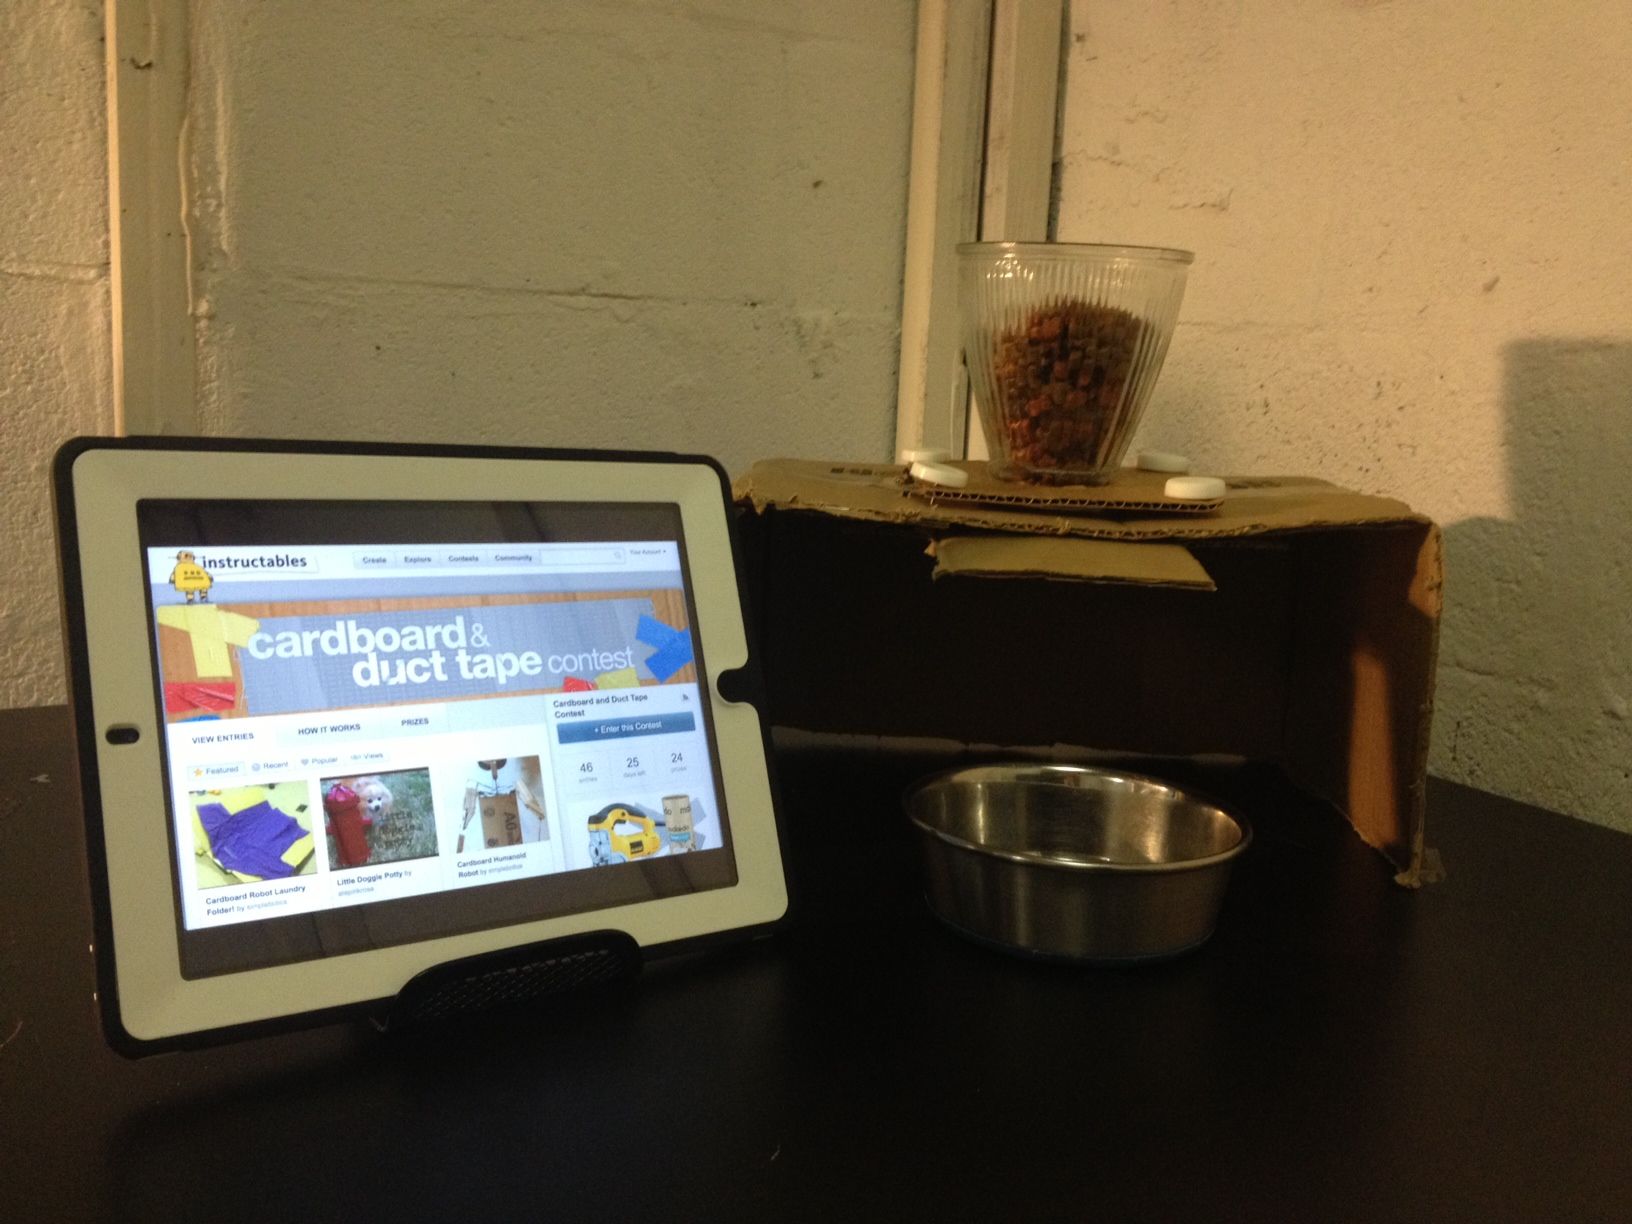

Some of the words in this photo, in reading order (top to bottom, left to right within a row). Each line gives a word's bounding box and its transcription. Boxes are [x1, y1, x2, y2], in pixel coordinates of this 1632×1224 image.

[202, 553, 307, 570] instructables
[362, 556, 387, 565] Create
[403, 555, 432, 565] Explore
[448, 554, 479, 563] Contests
[494, 553, 532, 563] Community
[248, 616, 467, 660] cardboard
[470, 622, 490, 648] &
[352, 655, 449, 688] duct
[455, 650, 543, 684] tape
[548, 646, 635, 674] contest
[553, 698, 594, 709] Cardboard
[596, 697, 610, 706] and
[611, 695, 629, 704] Duct
[630, 693, 649, 703] Tape
[554, 709, 585, 719] Contest
[401, 717, 429, 727] PRIZES
[601, 723, 620, 735] Enter
[621, 722, 634, 732] this
[635, 720, 662, 731] Contest
[298, 727, 318, 736] HOW
[320, 726, 328, 735] IT
[330, 724, 361, 733] WORKS
[192, 735, 215, 744] VIEW
[217, 733, 254, 742] ENTRIES
[311, 756, 338, 766] Popular
[364, 751, 384, 760] Views
[671, 752, 683, 763] 24
[263, 761, 288, 770] Recent
[580, 762, 594, 773] 46
[627, 757, 640, 768] 25
[206, 765, 239, 775] Featured
[457, 855, 493, 868] Cardboard
[494, 852, 527, 865] Humanoid
[337, 874, 357, 886] Little
[357, 872, 383, 885] Doggie
[384, 869, 403, 881] Potty
[404, 868, 412, 877] by
[458, 868, 479, 878] Robot
[480, 867, 487, 876] by
[205, 891, 248, 905] Cardboard
[249, 887, 274, 899] Robot
[275, 883, 306, 896] Laundry
[206, 905, 235, 916] Folder!
[236, 903, 245, 912] by
